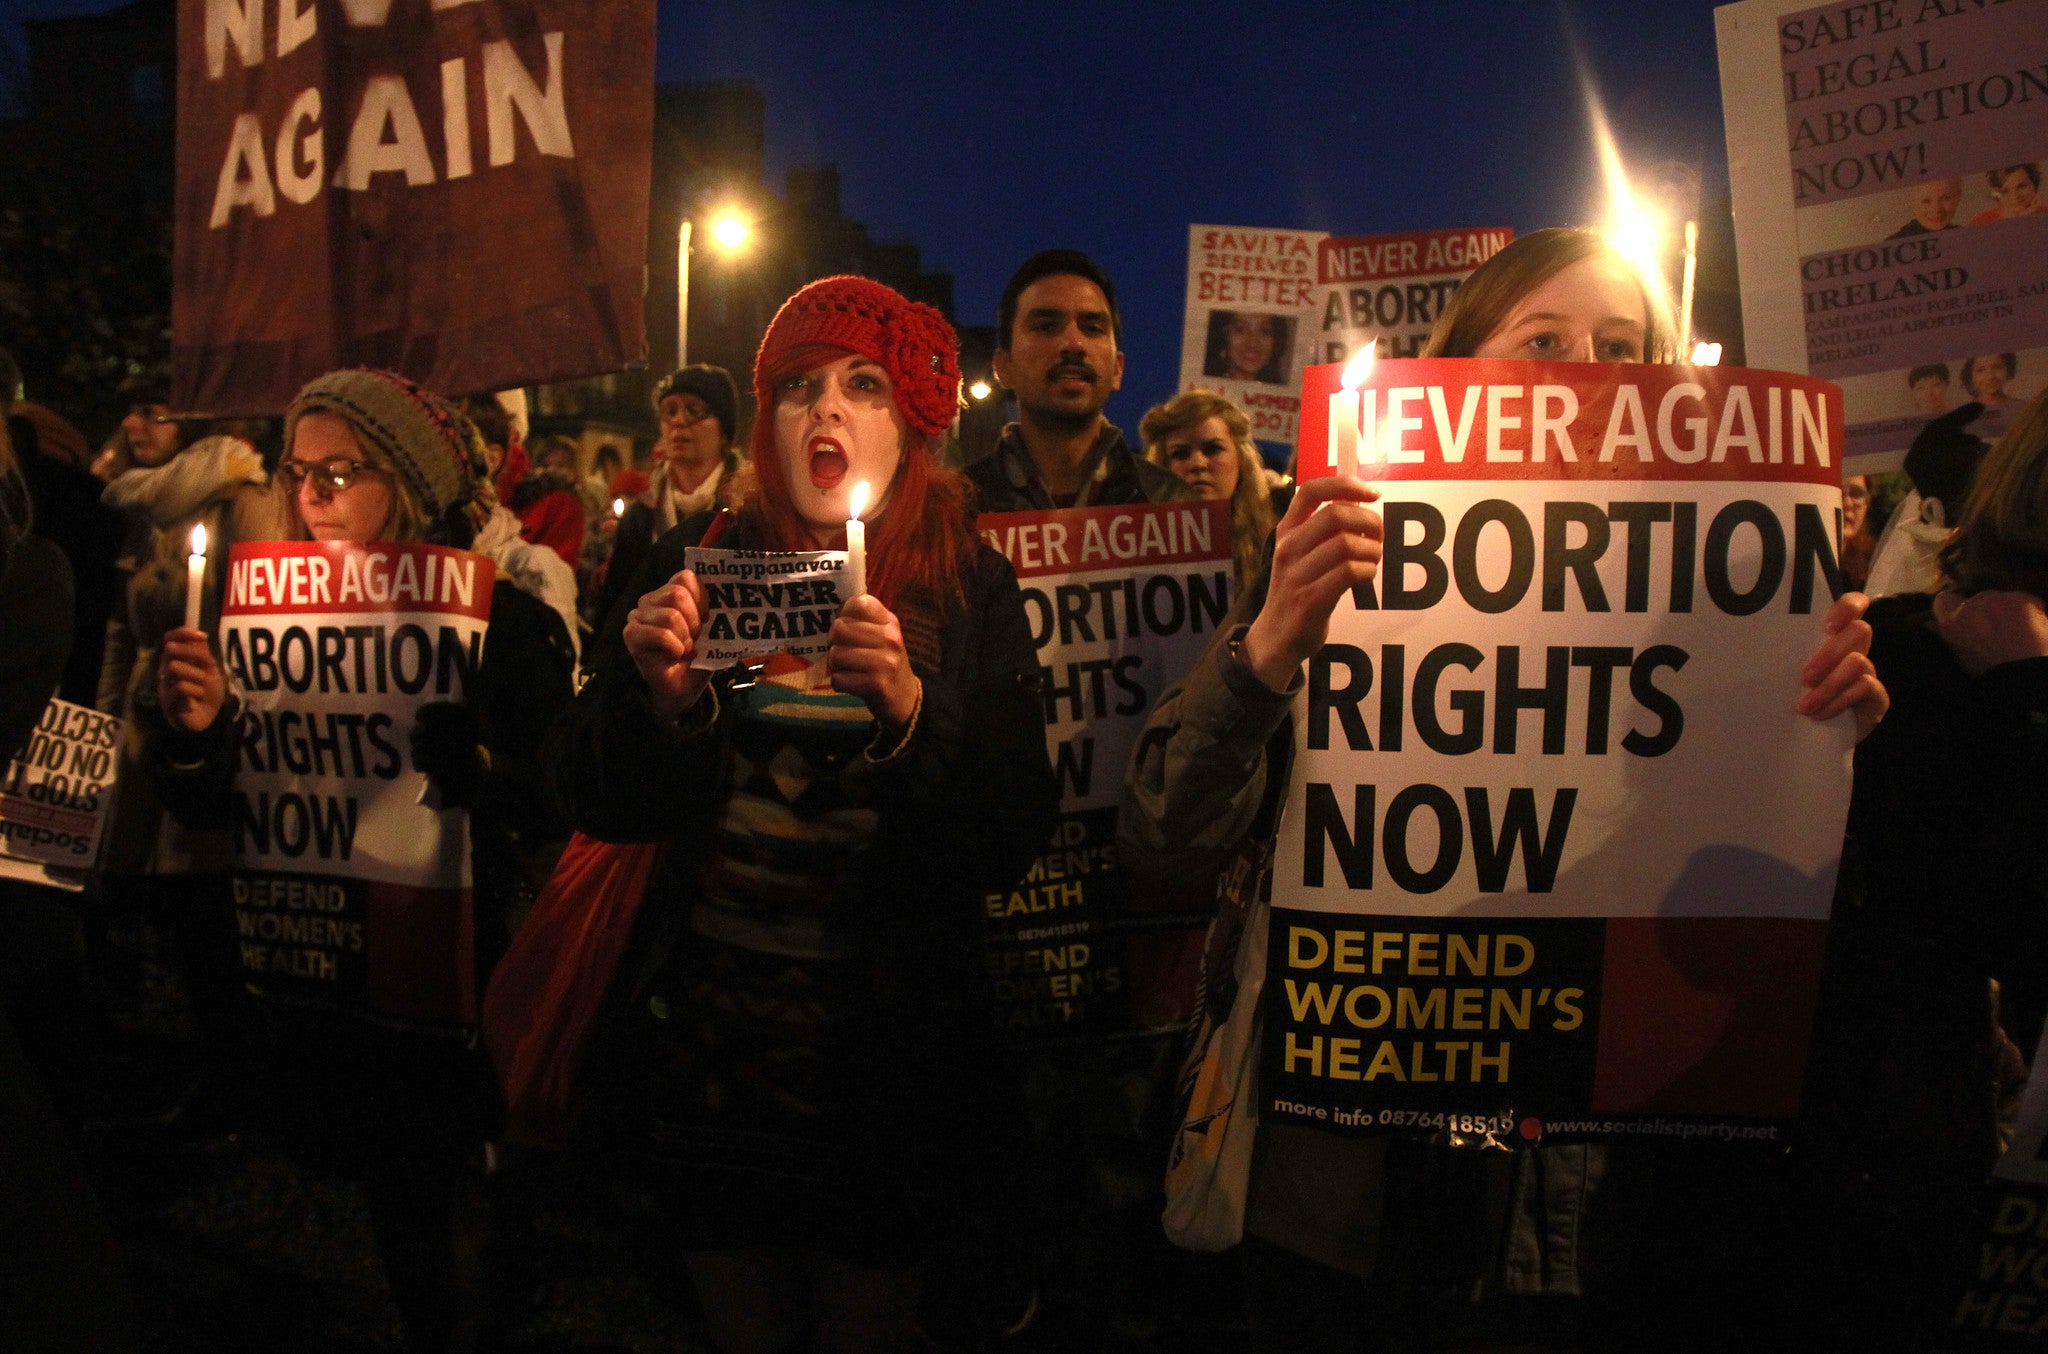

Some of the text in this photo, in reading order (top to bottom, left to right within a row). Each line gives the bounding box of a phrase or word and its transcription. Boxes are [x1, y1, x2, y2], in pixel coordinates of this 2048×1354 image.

[1780, 0, 1902, 55] SAFE
[1785, 40, 1947, 103] LEGAL
[209, 31, 575, 230] AGAIN
[1790, 63, 2048, 152] ABORTION
[1795, 142, 1928, 199] NOW!
[1202, 231, 1312, 257] SAVITA
[1327, 231, 1507, 279] NEVER AGAIN
[1802, 238, 1942, 282] CHOICE
[1198, 271, 1316, 306] BETTER
[1322, 278, 1459, 332] ABORT
[1805, 266, 1969, 314] IRELAND
[1328, 383, 1831, 468] NEVER AGAIN
[1080, 508, 1212, 563] AGAIN
[229, 552, 475, 609] NEVER AGAIN
[695, 558, 844, 580] Halappanavar
[705, 580, 842, 610] NEVER
[708, 608, 832, 641] AGAIN
[1017, 570, 1228, 650] ORTION
[225, 624, 482, 696] ABORTION
[38, 702, 120, 749] SECTO
[1305, 642, 1691, 758] RIGHTS
[25, 733, 111, 780] ON OU
[236, 710, 402, 781] RIGHTS
[236, 791, 358, 862] NOW
[1302, 781, 1579, 894] NOW
[232, 876, 346, 912] DEFEND
[985, 881, 1084, 919] EALTH
[241, 943, 337, 981] HEALTH
[1287, 925, 1536, 977] DEFEND
[1283, 978, 1586, 1032] WOMEN'S
[1283, 1032, 1511, 1084] HEALTH
[1273, 1100, 1778, 1142] more info 0876418519 www.socialistparty.net
